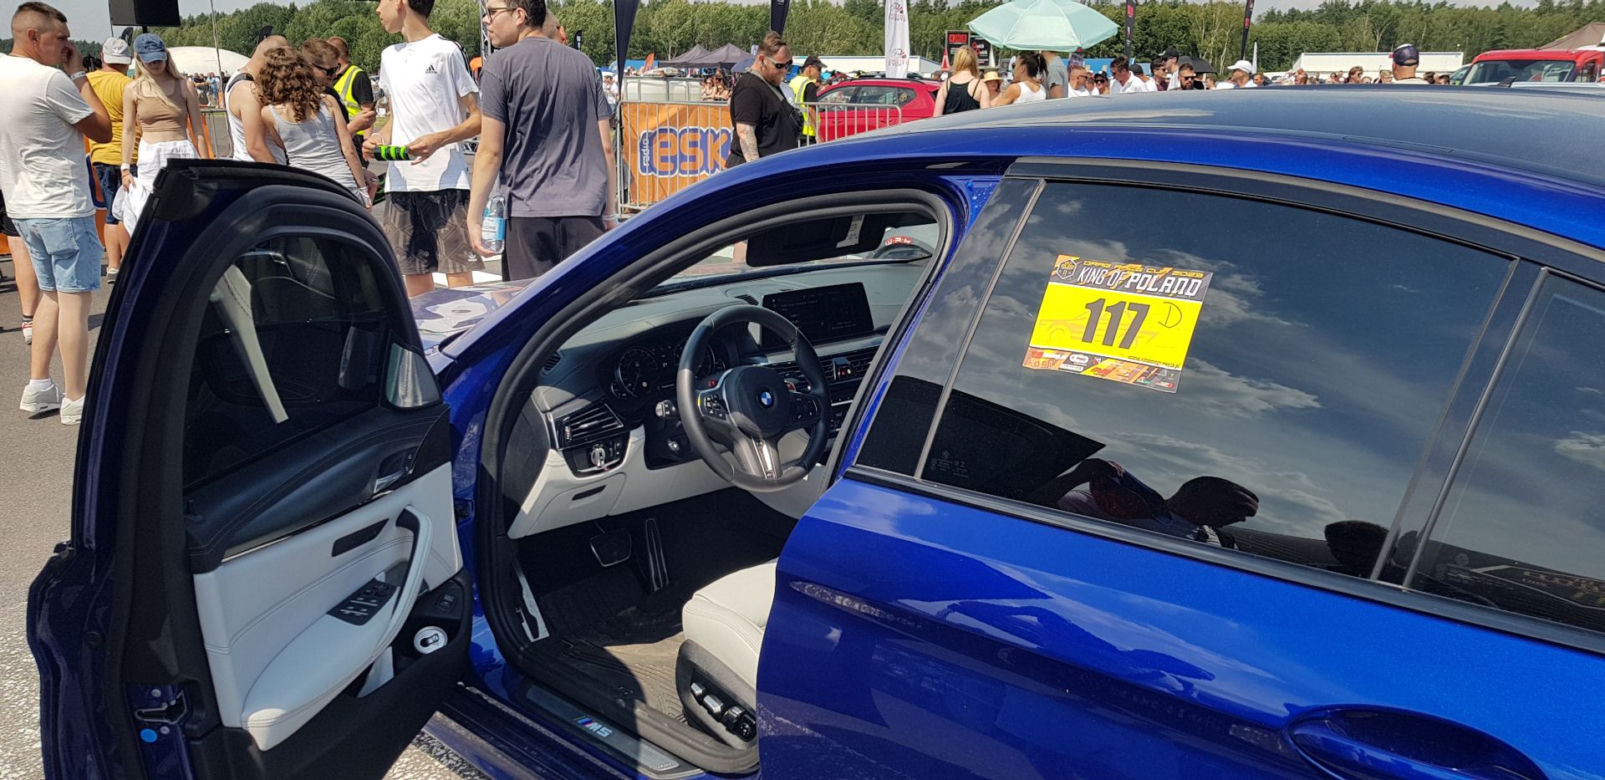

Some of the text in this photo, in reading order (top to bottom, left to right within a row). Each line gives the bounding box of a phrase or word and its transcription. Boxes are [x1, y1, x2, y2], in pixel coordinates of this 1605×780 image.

[1077, 267, 1106, 285] KING
[1107, 270, 1127, 287] OF
[1125, 272, 1203, 297] POLAND
[1081, 297, 1151, 350] 117
[1158, 301, 1183, 329] D
[584, 721, 613, 738] M5
